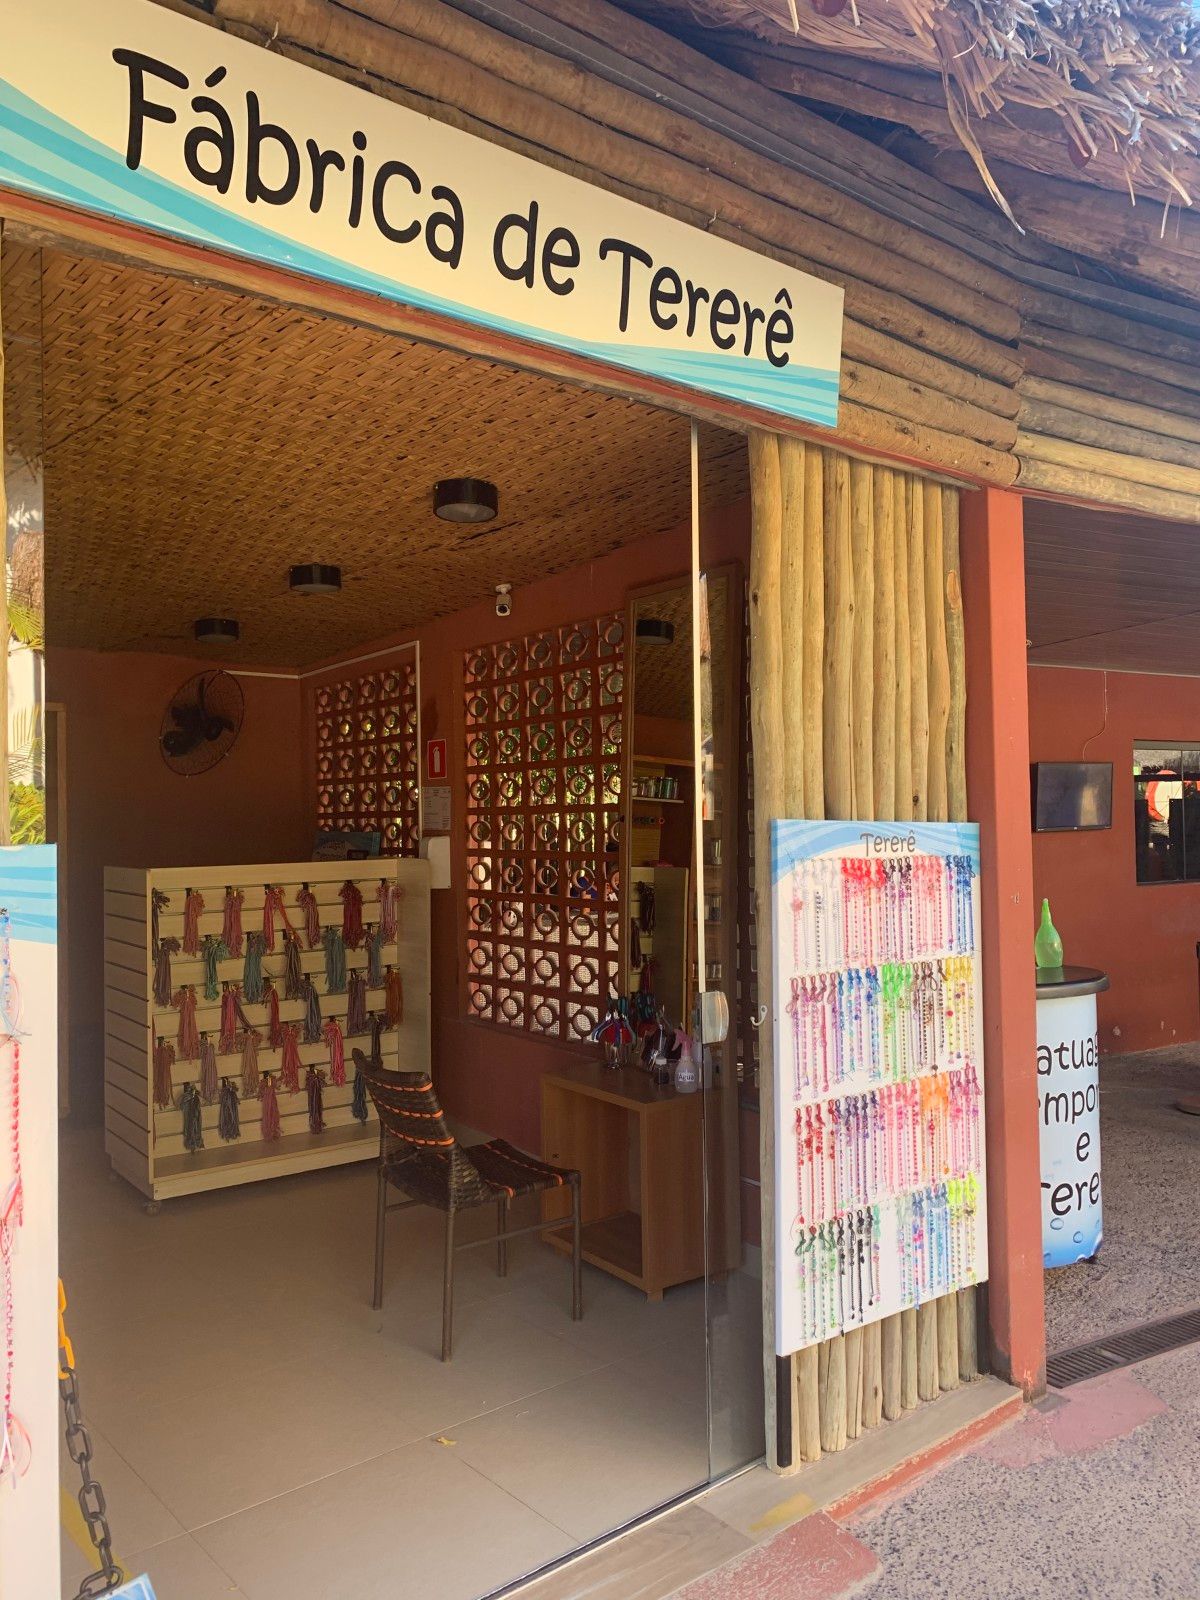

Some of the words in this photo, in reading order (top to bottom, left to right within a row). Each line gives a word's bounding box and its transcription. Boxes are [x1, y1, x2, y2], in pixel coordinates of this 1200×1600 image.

[112, 48, 464, 270] Fábrica
[493, 200, 580, 296] de
[599, 238, 794, 368] Tererê
[860, 830, 916, 857] Tererê
[1038, 1084, 1099, 1125] mpo
[1076, 1131, 1091, 1162] e
